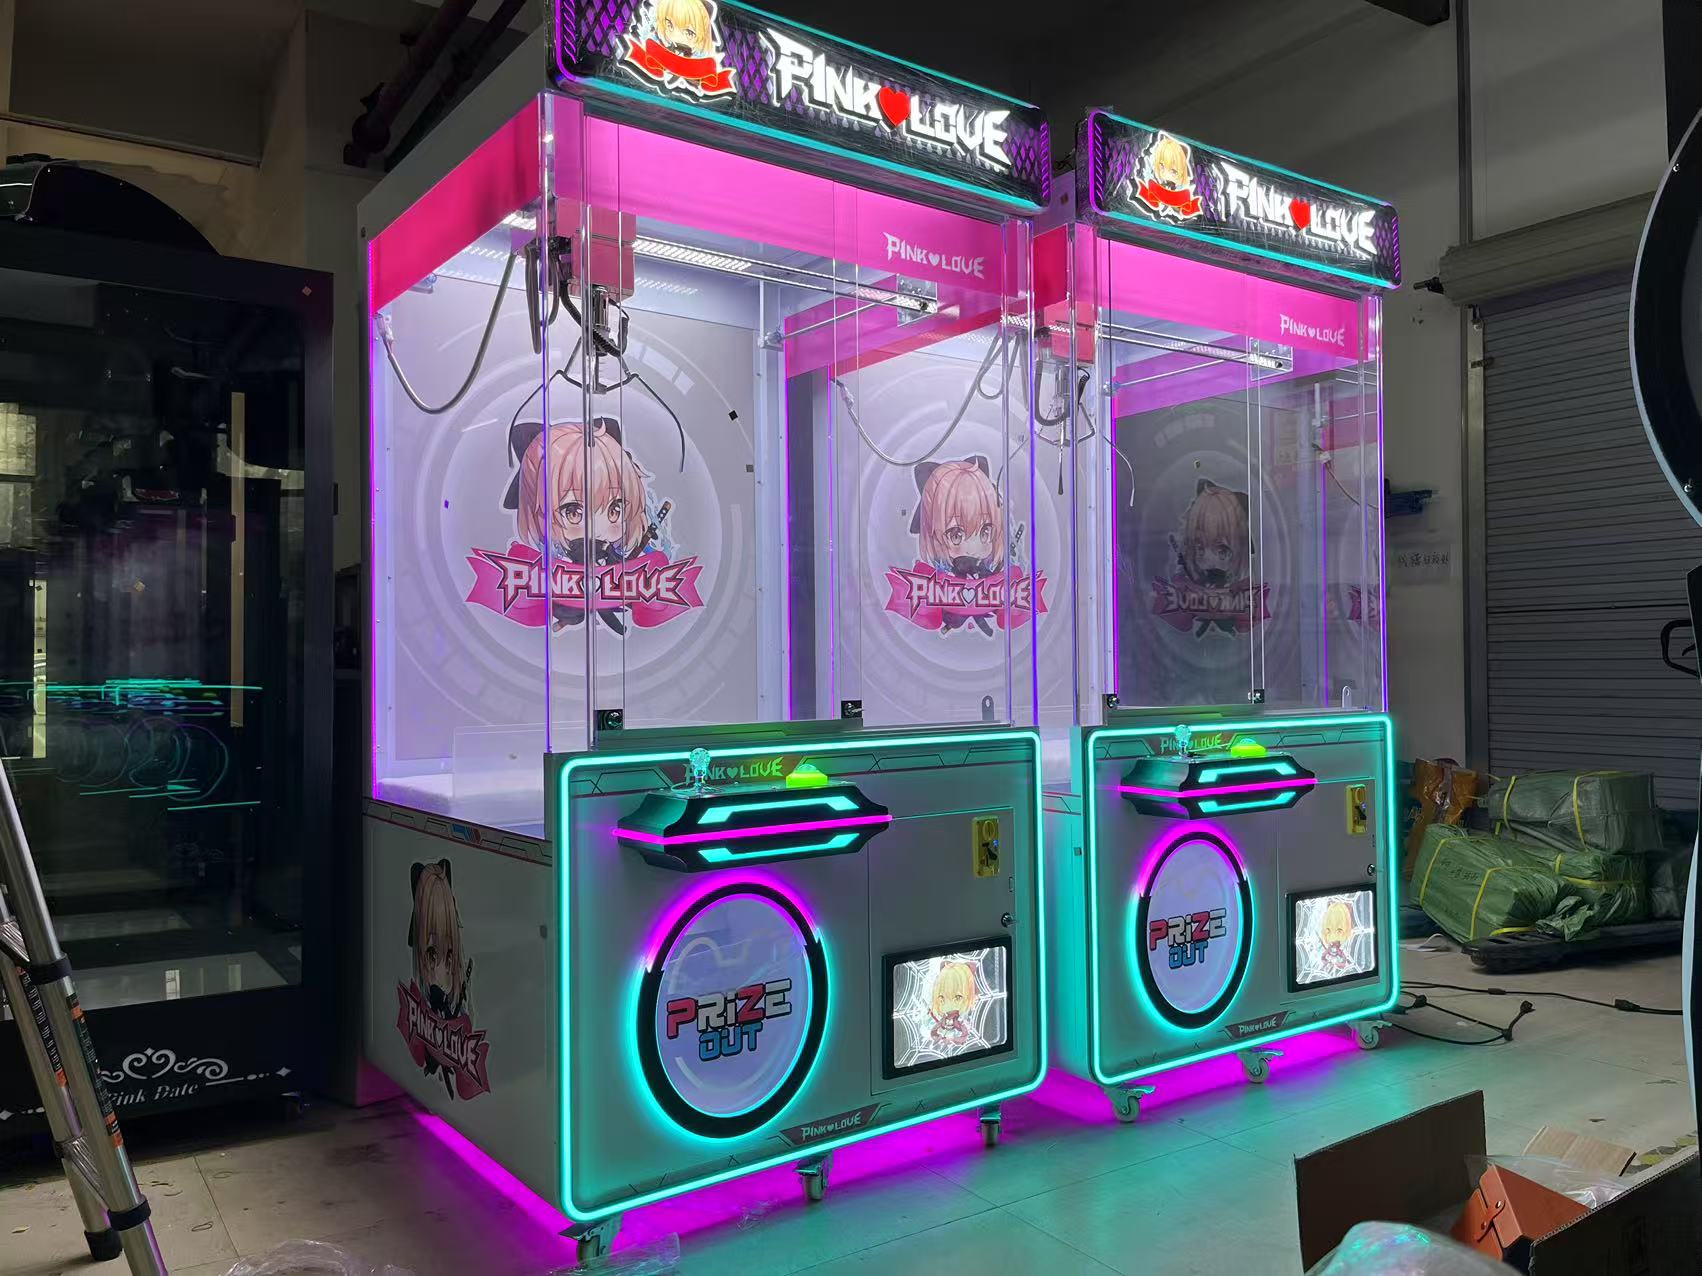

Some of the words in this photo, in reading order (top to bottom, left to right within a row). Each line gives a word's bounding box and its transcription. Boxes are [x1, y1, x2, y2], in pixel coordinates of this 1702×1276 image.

[765, 28, 882, 122] PINK
[909, 95, 1012, 167] LOVE
[1219, 162, 1294, 226] PINK
[1309, 204, 1378, 256] LOVE
[882, 231, 928, 265] PINK
[941, 254, 985, 279] LOVE
[1280, 313, 1308, 337] PINK
[1316, 328, 1345, 347] LOVE
[494, 557, 583, 605] PINK
[602, 562, 686, 603] LOVE
[904, 574, 963, 609] PINK
[740, 756, 784, 778] LOVE
[1168, 940, 1209, 969] OUT
[405, 990, 435, 1043] PINK
[443, 1027, 480, 1080] LOVE
[699, 1021, 763, 1061] OUT
[1238, 1024, 1254, 1036] PINK
[154, 1083, 199, 1100] Date
[801, 1127, 827, 1141] PINK
[835, 1112, 862, 1129] LOVE
